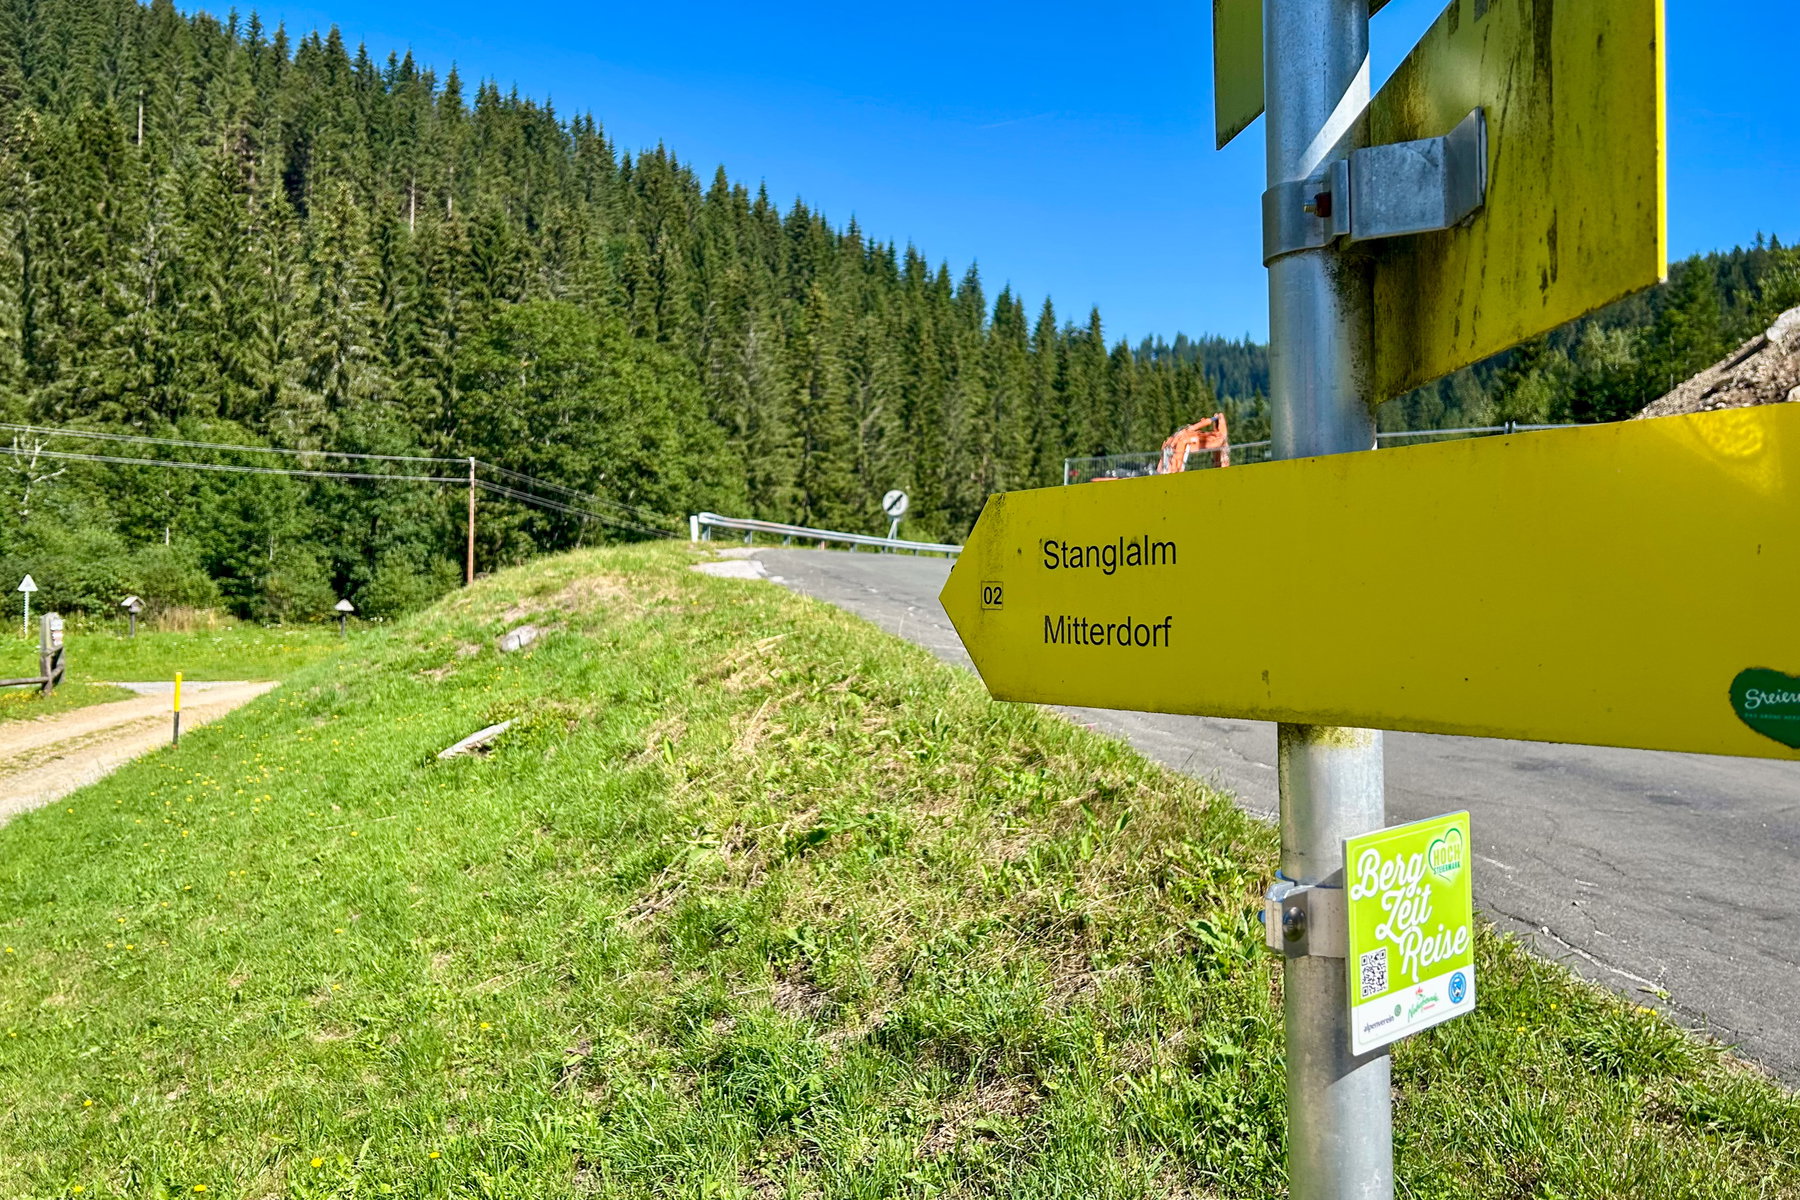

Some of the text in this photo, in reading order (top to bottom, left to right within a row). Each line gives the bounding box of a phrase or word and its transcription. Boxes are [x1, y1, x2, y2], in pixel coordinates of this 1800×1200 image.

[1043, 535, 1177, 575] Stanglalm
[983, 586, 1003, 605] 02
[1043, 615, 1172, 647] Mitterdorf
[1744, 688, 1800, 710] Steier
[1433, 843, 1460, 866] HOCH
[1433, 861, 1461, 875] STEIERMARK
[1350, 848, 1428, 900] Berg
[1375, 884, 1433, 944] Zeit
[1399, 923, 1470, 983] Reise
[1363, 1016, 1395, 1033] alpenverein
